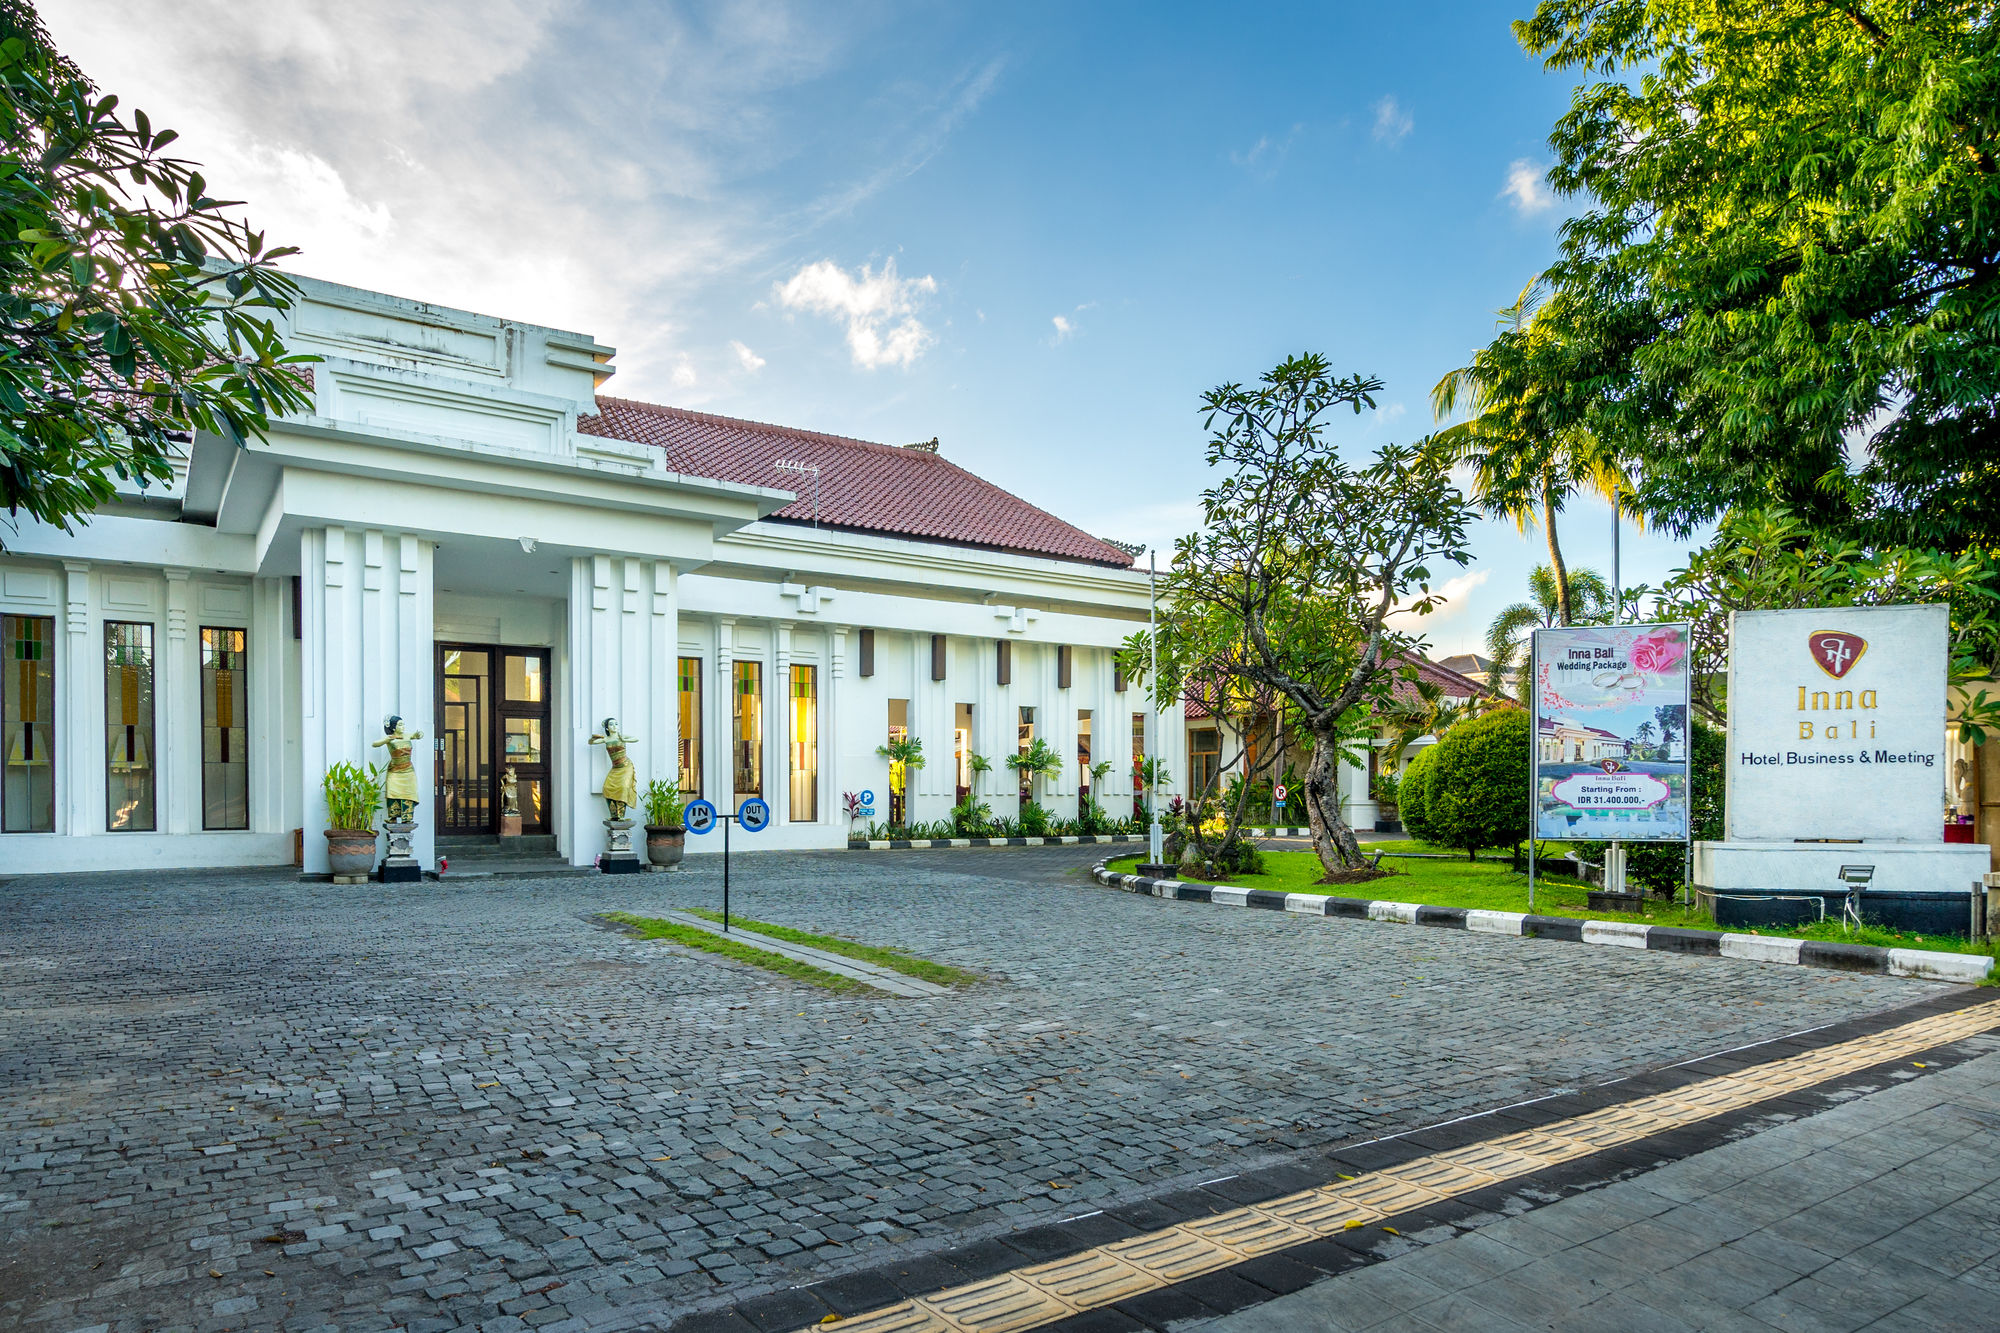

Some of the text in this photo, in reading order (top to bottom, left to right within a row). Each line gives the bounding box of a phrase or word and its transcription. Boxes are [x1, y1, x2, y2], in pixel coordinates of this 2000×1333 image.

[1568, 647, 1614, 659] Inna Bali
[1557, 661, 1627, 671] Wedding Package
[1797, 685, 1878, 711] Inna
[1798, 720, 1876, 740] Bali
[1741, 750, 1935, 766] Hotel, Business & Meeting
[1581, 785, 1613, 794] Starting
[1615, 785, 1637, 793] From
[863, 792, 872, 803] P
[1577, 796, 1646, 805] IDR 31.400.000,-
[692, 807, 708, 817] IN
[745, 805, 762, 815] OUT
